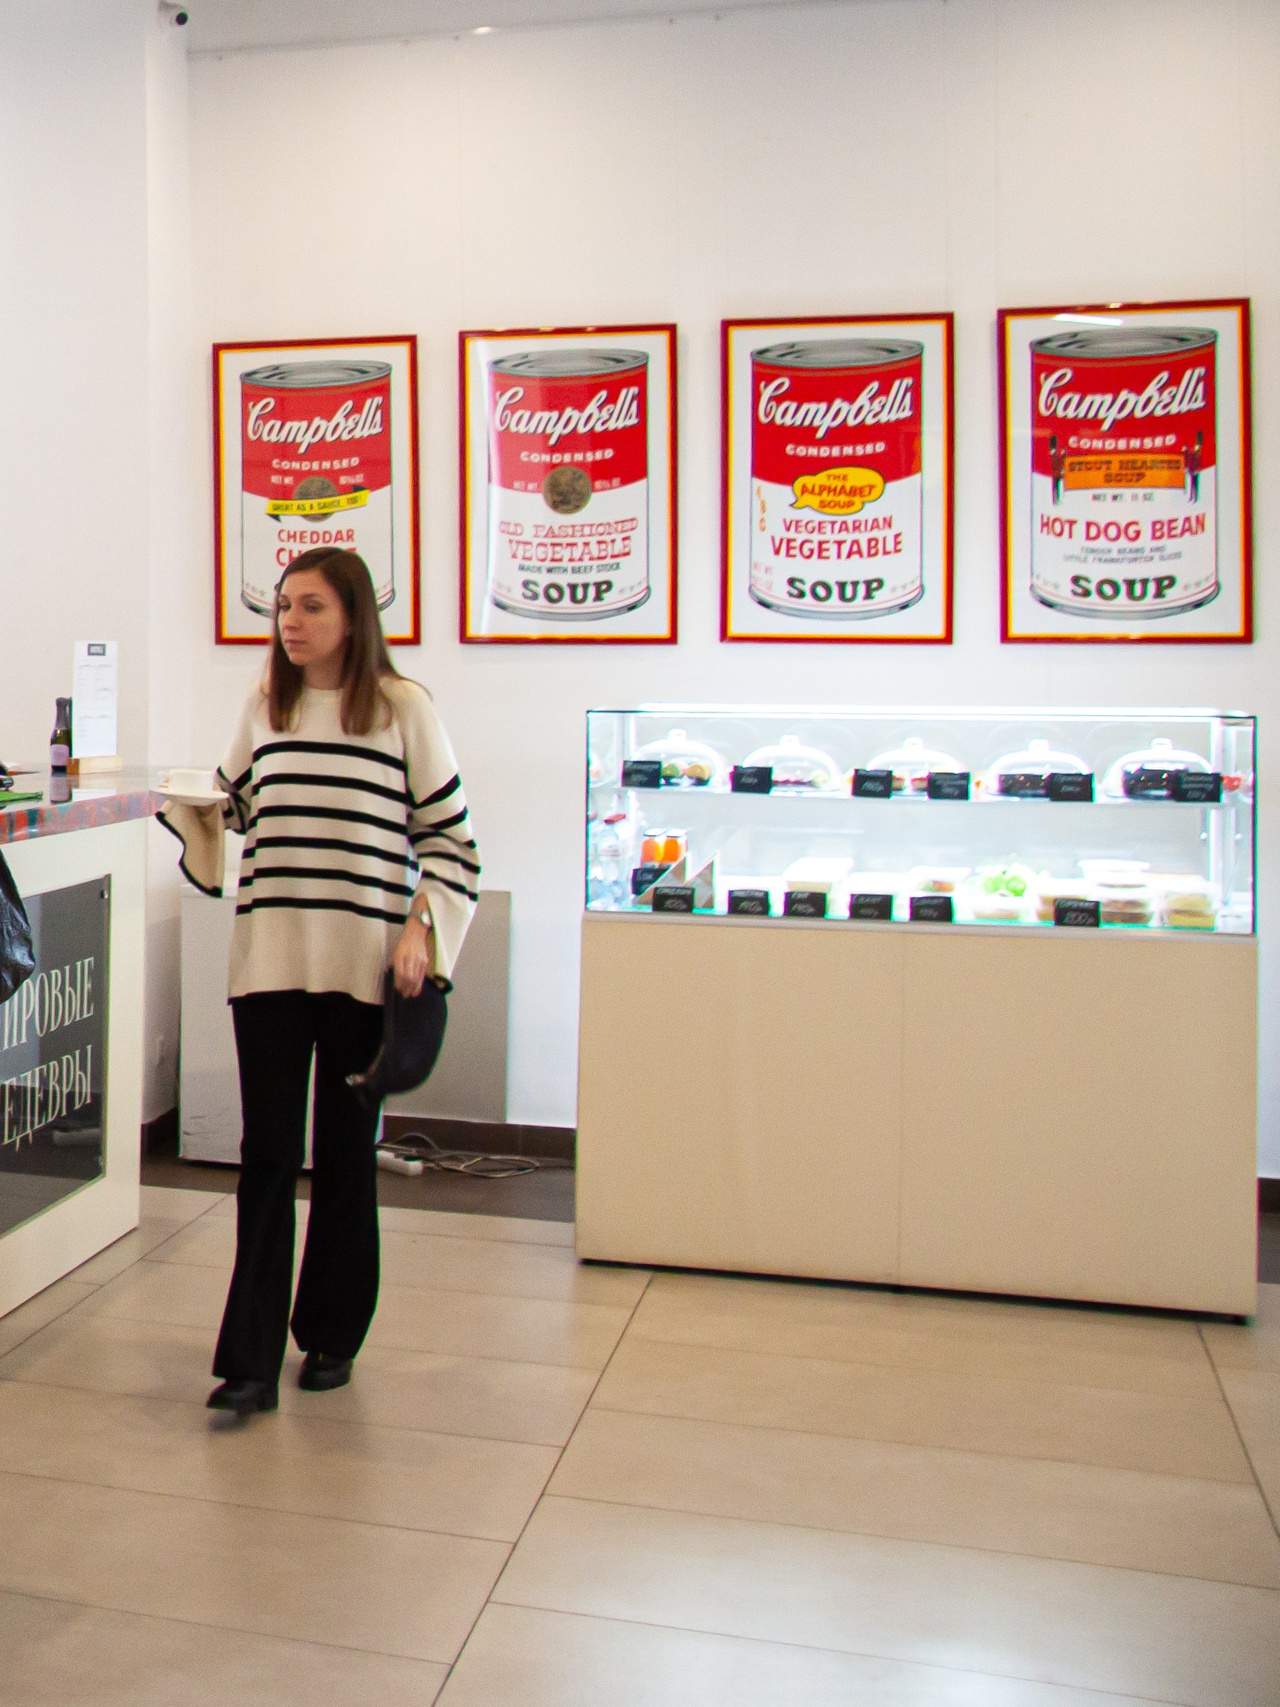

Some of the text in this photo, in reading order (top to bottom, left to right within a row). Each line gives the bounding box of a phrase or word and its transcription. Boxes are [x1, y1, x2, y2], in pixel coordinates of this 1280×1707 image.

[785, 441, 886, 457] CONDENSED
[1068, 434, 1177, 450] CONDENSED
[272, 457, 360, 471] CONDENSED
[520, 448, 614, 463] CONDENSED
[826, 473, 849, 482] THE
[800, 484, 878, 497] ALPHABET
[819, 499, 856, 509] SOUP
[499, 517, 638, 538] OLD FASHIONED
[783, 515, 893, 534] VEGETARIAN
[1040, 512, 1206, 542] HOT DOG BEAN
[277, 528, 355, 544] CHEDDAR
[508, 535, 631, 562] VEGETABLE
[771, 532, 903, 560] VEGETABLE
[521, 579, 614, 604] SOUP
[786, 576, 885, 602] SOUP
[1071, 574, 1177, 601] SOUP
